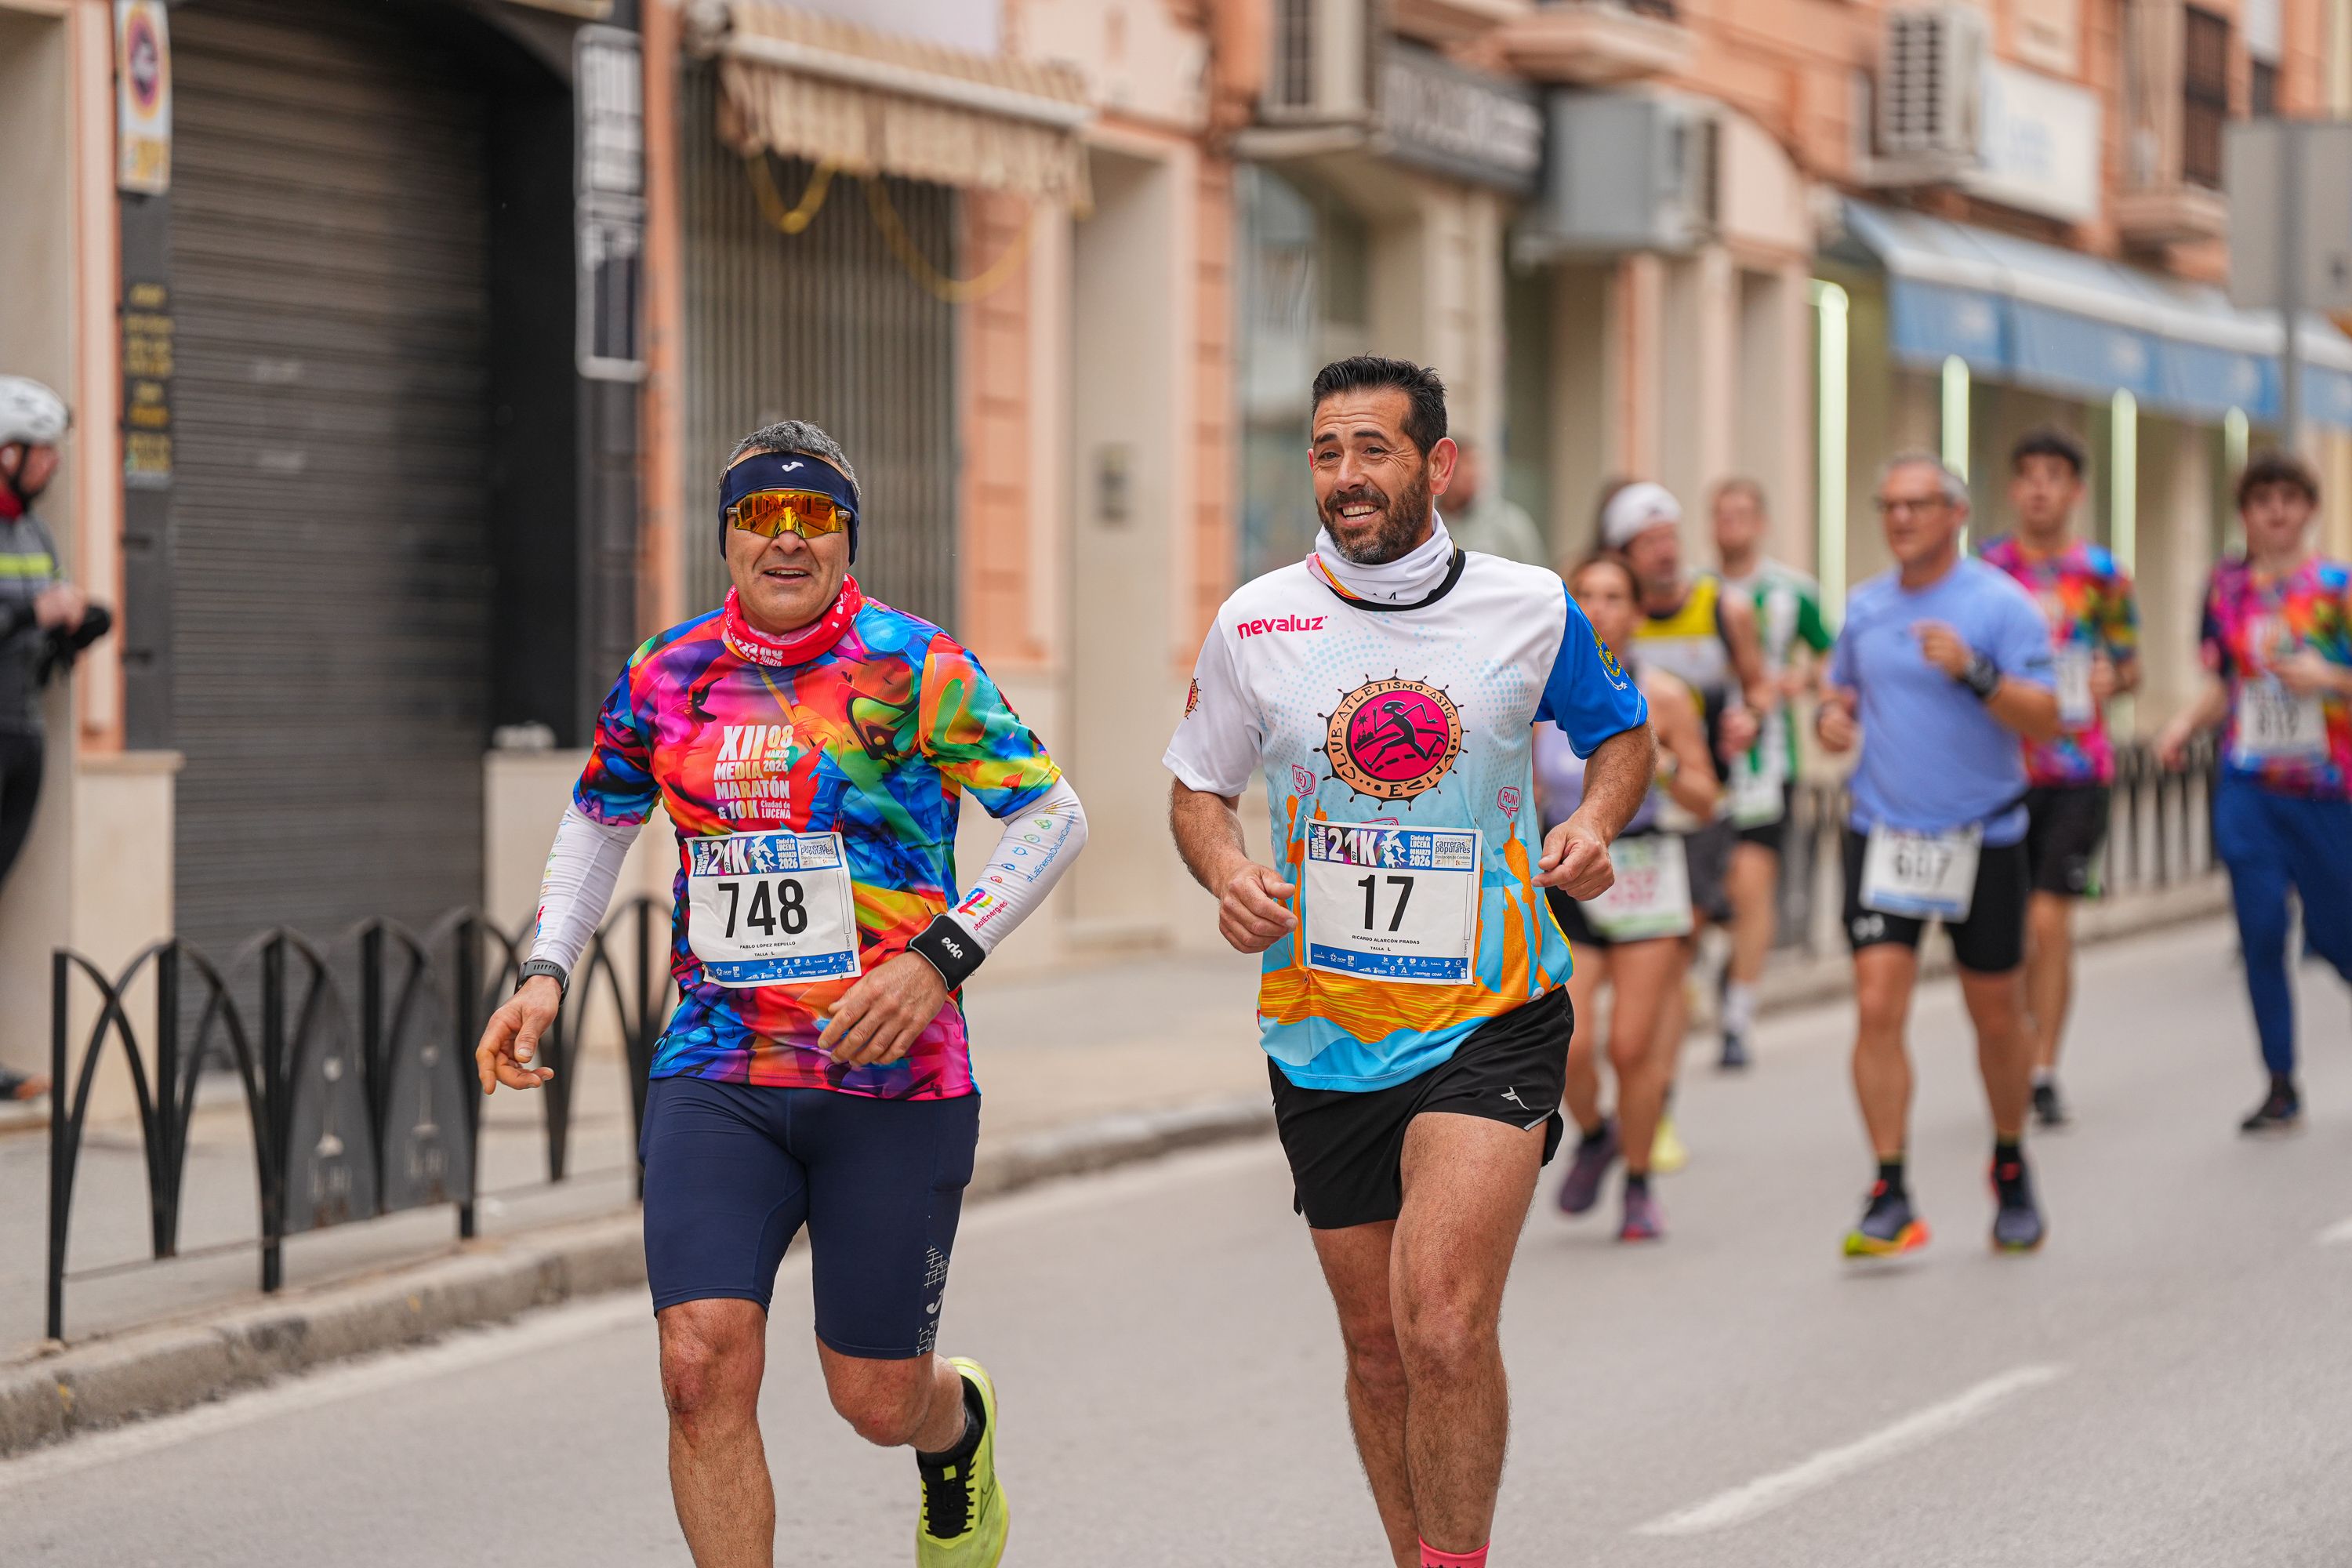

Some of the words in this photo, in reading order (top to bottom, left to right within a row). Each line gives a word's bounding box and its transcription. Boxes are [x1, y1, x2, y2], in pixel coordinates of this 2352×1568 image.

[1237, 615, 1323, 639] nevaluz
[1338, 681, 1423, 722] ATLETISMO
[1428, 691, 1457, 726] ASTIGI
[717, 725, 767, 761] XII
[767, 724, 794, 748] 08
[764, 750, 790, 758] MARZO
[1330, 728, 1356, 779] CLUB
[713, 761, 764, 781] MEDIA
[763, 760, 789, 772] 2026
[713, 776, 790, 800] MARATÓN
[760, 800, 782, 808] Ciudad
[1503, 791, 1518, 806] RUN!
[717, 807, 727, 819] &
[728, 800, 759, 819] 10K
[761, 808, 791, 819] LUCENA
[777, 843, 796, 851] LUCENA
[800, 846, 834, 855] populares
[1328, 827, 1377, 866] 21K
[1435, 846, 1471, 855] populares
[707, 839, 750, 874] 21K
[779, 858, 799, 869] 2026
[1409, 855, 1431, 866] 2026
[718, 878, 808, 938] 748
[1358, 874, 1414, 931] 17
